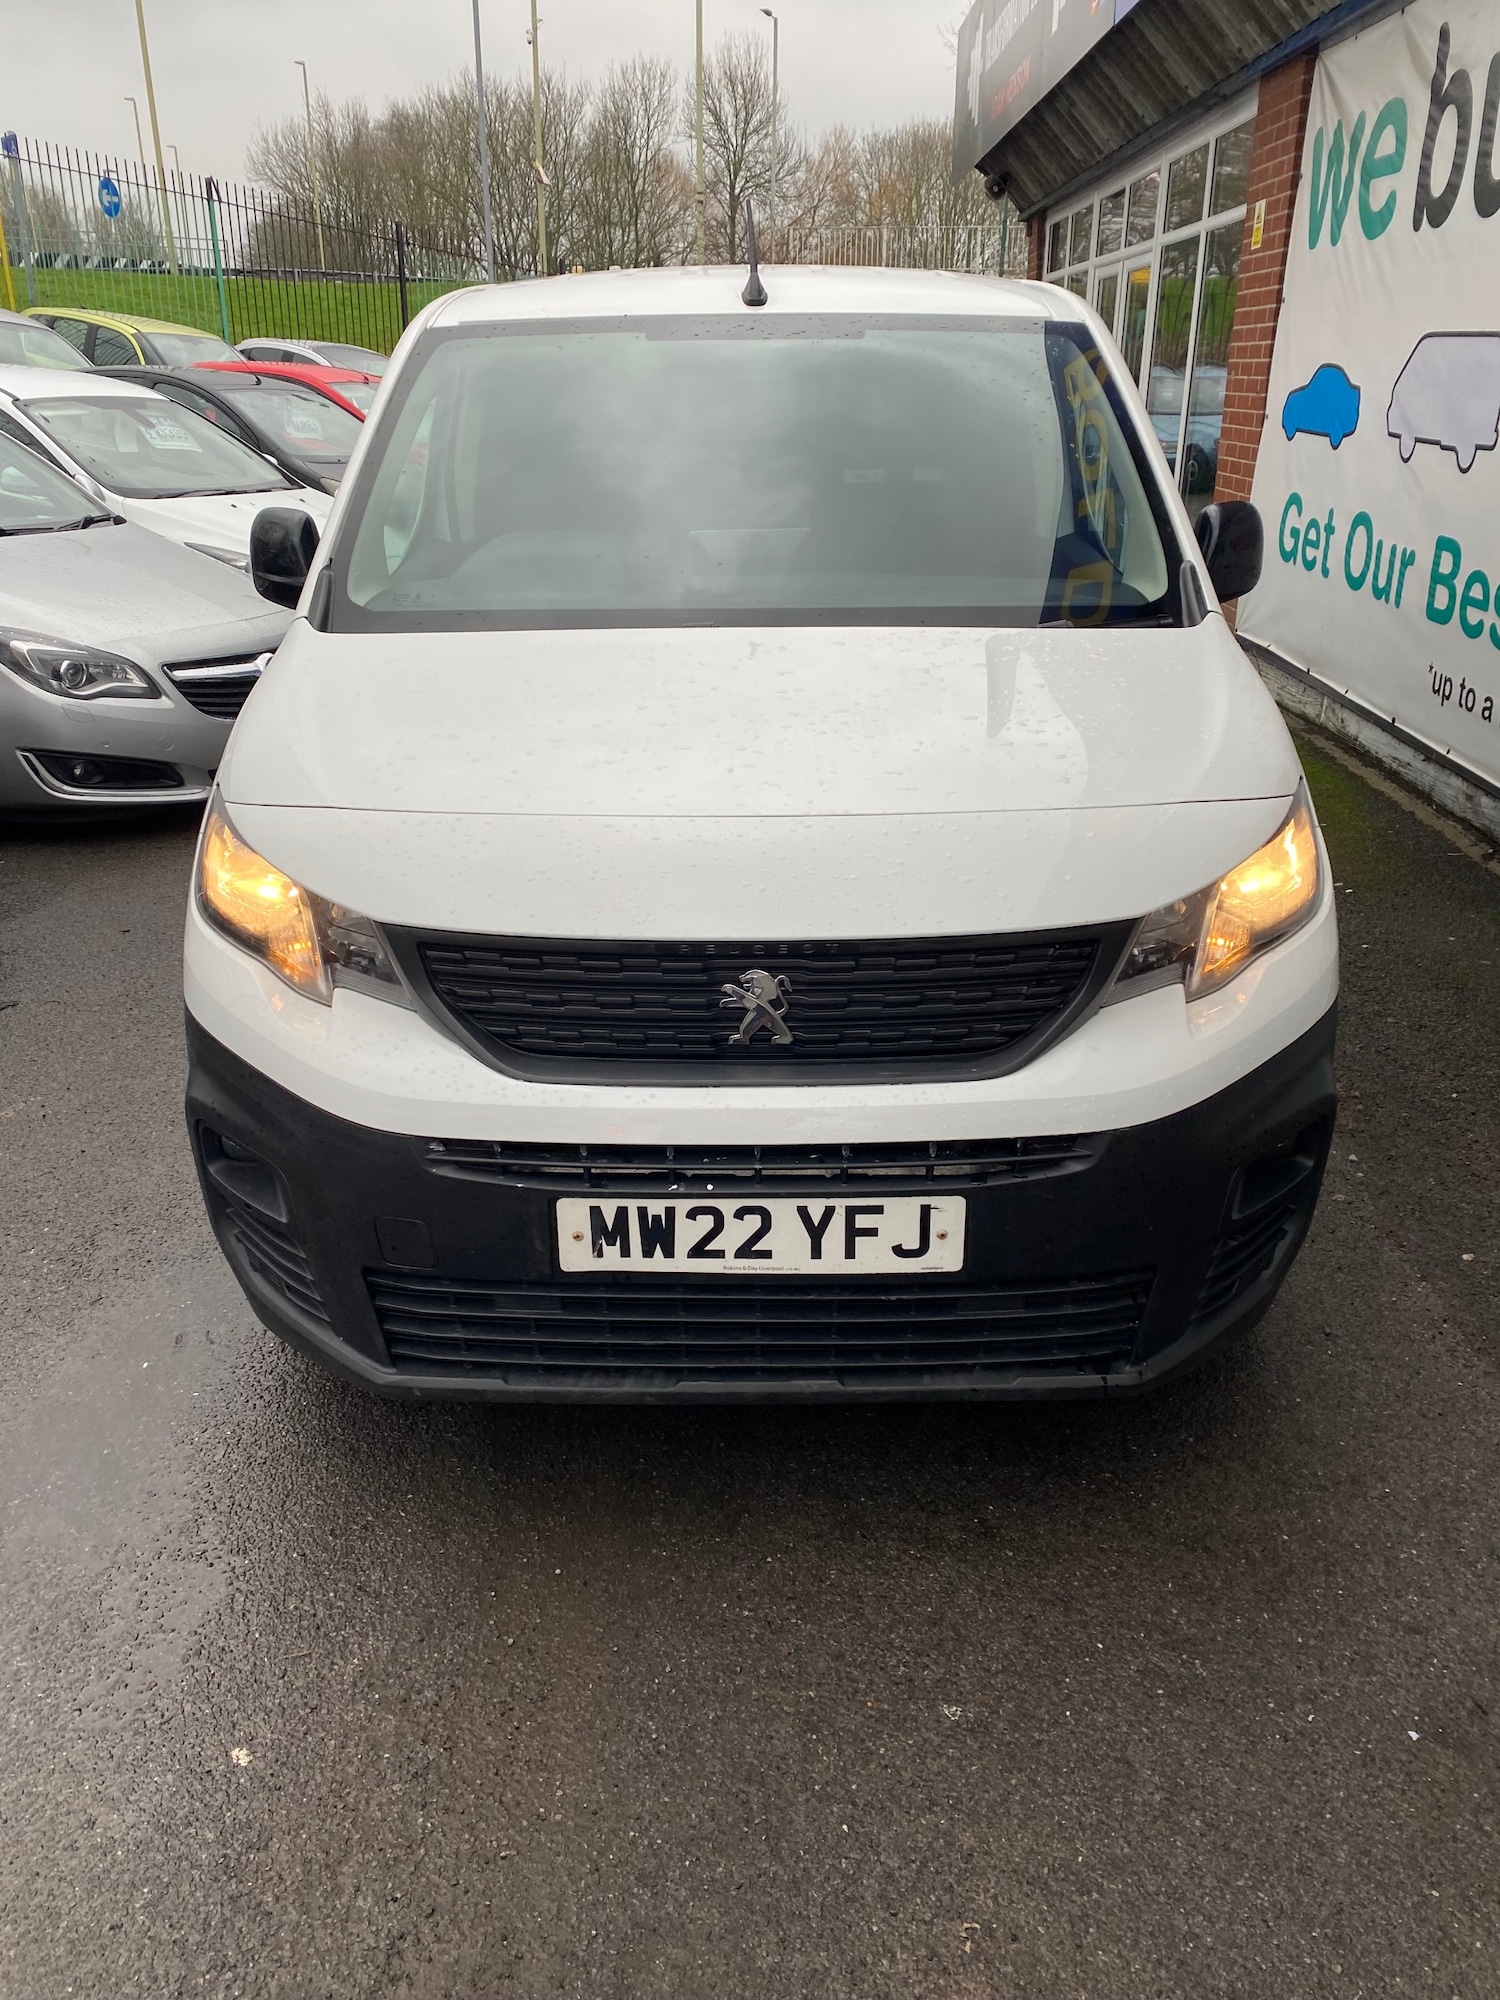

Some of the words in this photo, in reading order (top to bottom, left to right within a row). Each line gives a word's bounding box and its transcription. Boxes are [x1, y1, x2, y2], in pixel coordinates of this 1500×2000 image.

[1278, 491, 1335, 579] Get
[1344, 511, 1416, 609] Our
[1459, 677, 1476, 712] to
[1482, 695, 1494, 723] a
[679, 943, 840, 955] PEUGEOT
[588, 1204, 774, 1260] MW22
[796, 1203, 932, 1260] YFJ
